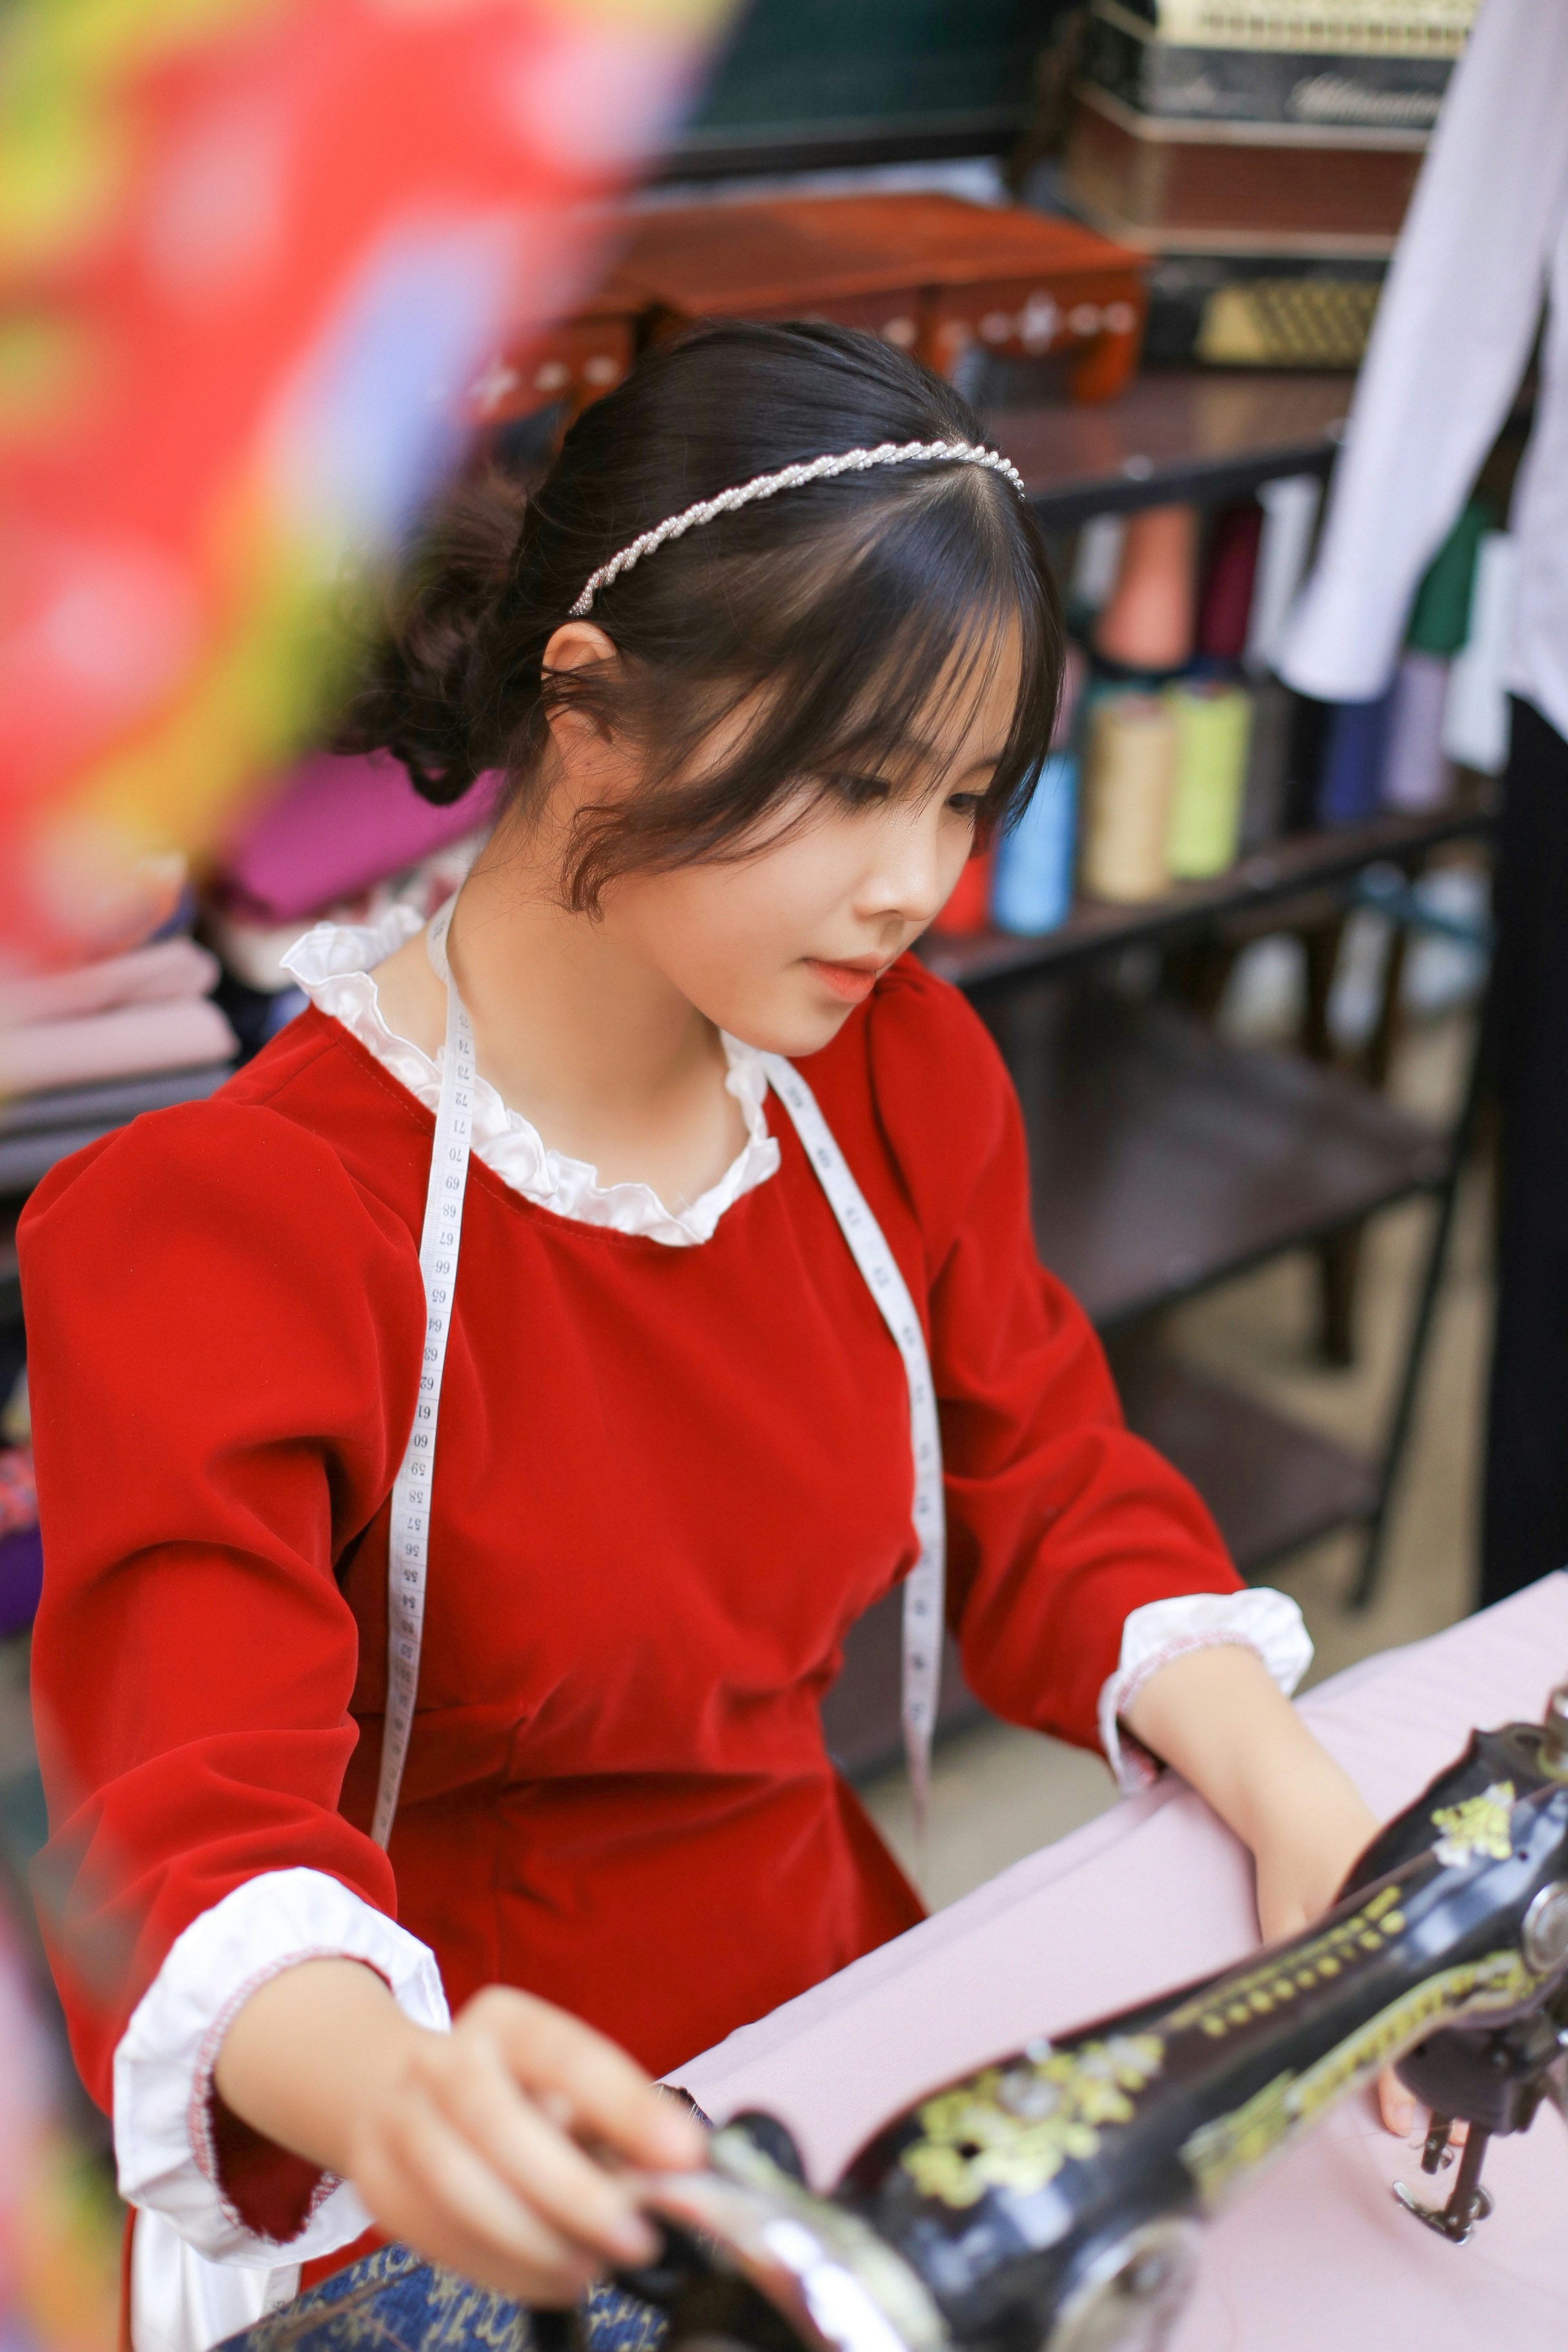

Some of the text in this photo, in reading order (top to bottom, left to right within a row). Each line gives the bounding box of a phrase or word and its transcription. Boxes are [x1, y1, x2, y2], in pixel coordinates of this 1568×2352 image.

[458, 1039, 470, 1054] 74
[457, 1065, 470, 1081] 73
[455, 1092, 468, 1107] 72
[453, 1119, 466, 1135] 71
[449, 1147, 463, 1162] 70
[446, 1175, 460, 1190] 69
[442, 1204, 457, 1218] 68
[439, 1231, 454, 1246] 67
[435, 1260, 451, 1274] 66
[432, 1289, 447, 1303] 65
[428, 1318, 442, 1332] 64
[424, 1348, 438, 1361] 63
[420, 1376, 435, 1390] 62
[418, 1405, 431, 1419] 61
[414, 1433, 428, 1448] 60
[411, 1462, 426, 1476] 59
[409, 1491, 424, 1504] 58
[407, 1517, 422, 1531] 57
[406, 1543, 420, 1556] 56
[404, 1569, 418, 1582] 55
[402, 1594, 416, 1609] 54
